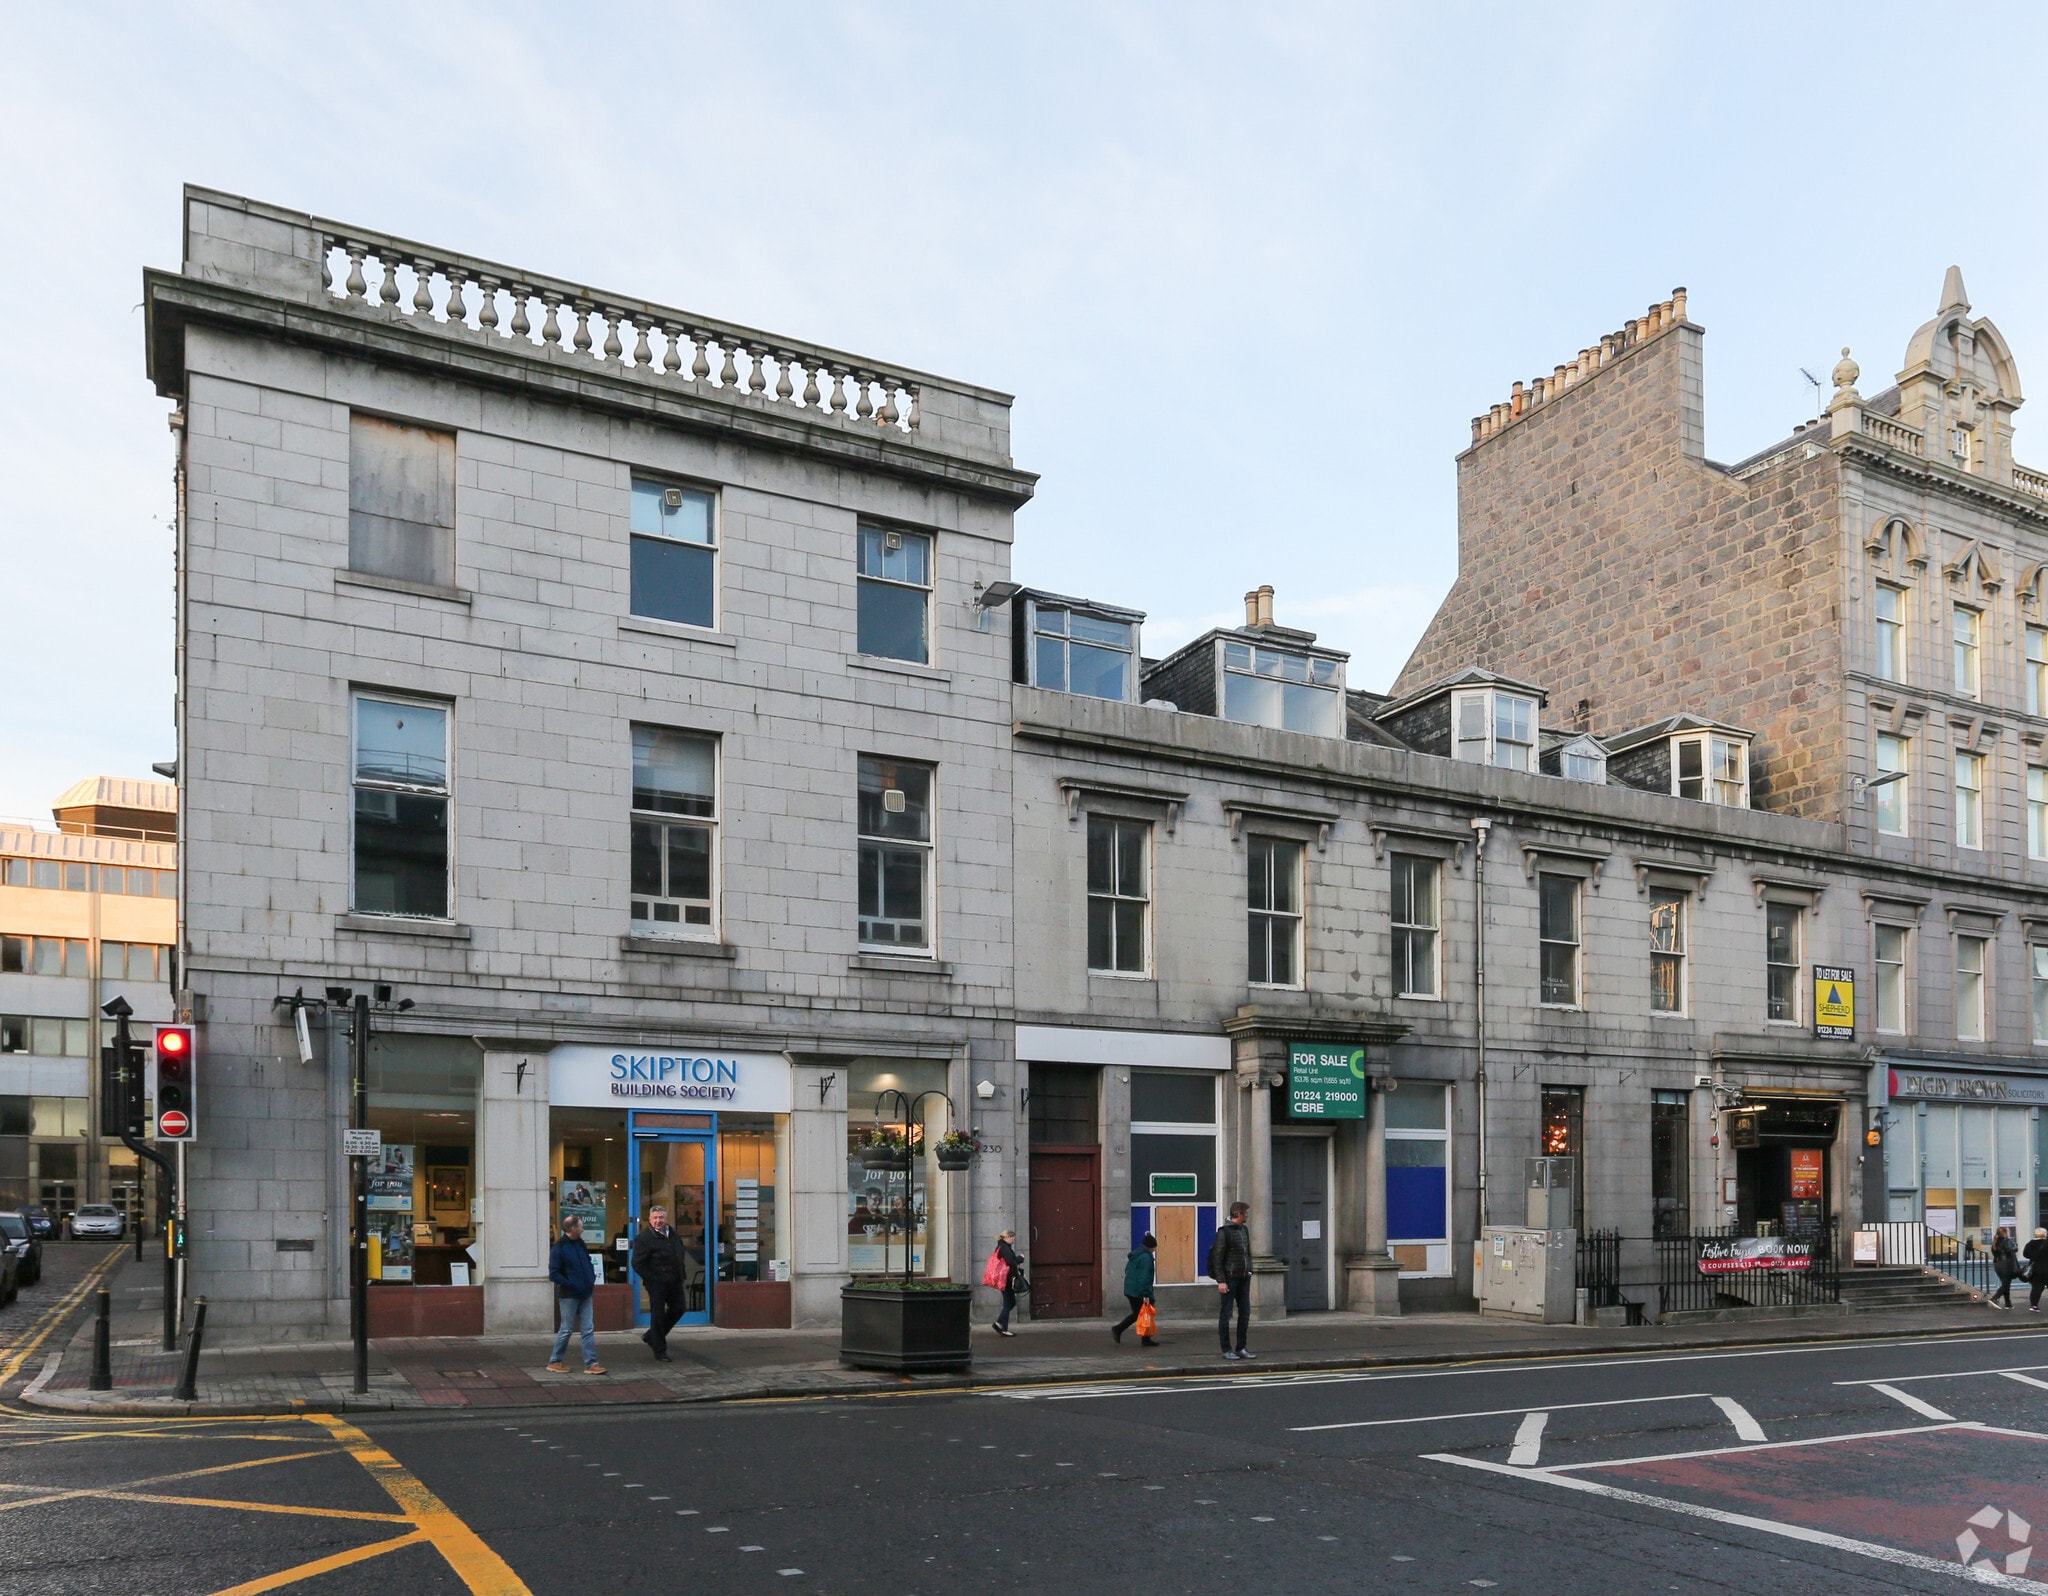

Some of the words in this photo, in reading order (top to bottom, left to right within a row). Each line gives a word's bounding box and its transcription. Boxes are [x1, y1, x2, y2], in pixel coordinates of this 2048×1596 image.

[1831, 969, 1840, 980] FOR
[1841, 970, 1852, 982] SALE
[1819, 1004, 1850, 1014] SHEPHERD
[1817, 1026, 1832, 1034] 01224
[1293, 1053, 1316, 1065] FOR
[1320, 1055, 1348, 1067] SALE
[610, 1054, 737, 1083] SKIPTON
[611, 1083, 677, 1098] BUILDING
[680, 1085, 736, 1101] SOCIETY
[1905, 1075, 1949, 1096] DIGBY
[1952, 1078, 2007, 1098] BROWN
[2008, 1088, 2045, 1099] SOLICITORS
[1293, 1091, 1321, 1100] 01224
[1325, 1092, 1358, 1101] 219000
[1294, 1102, 1324, 1113] CBRE
[983, 1145, 1002, 1153] 230
[863, 1169, 884, 1182] for
[369, 1179, 385, 1188] for
[386, 1180, 403, 1189] you
[1701, 1242, 1729, 1259] Festive
[1730, 1242, 1753, 1262] Fayre
[1758, 1244, 1784, 1254] BOOK
[1787, 1244, 1809, 1254] NOW
